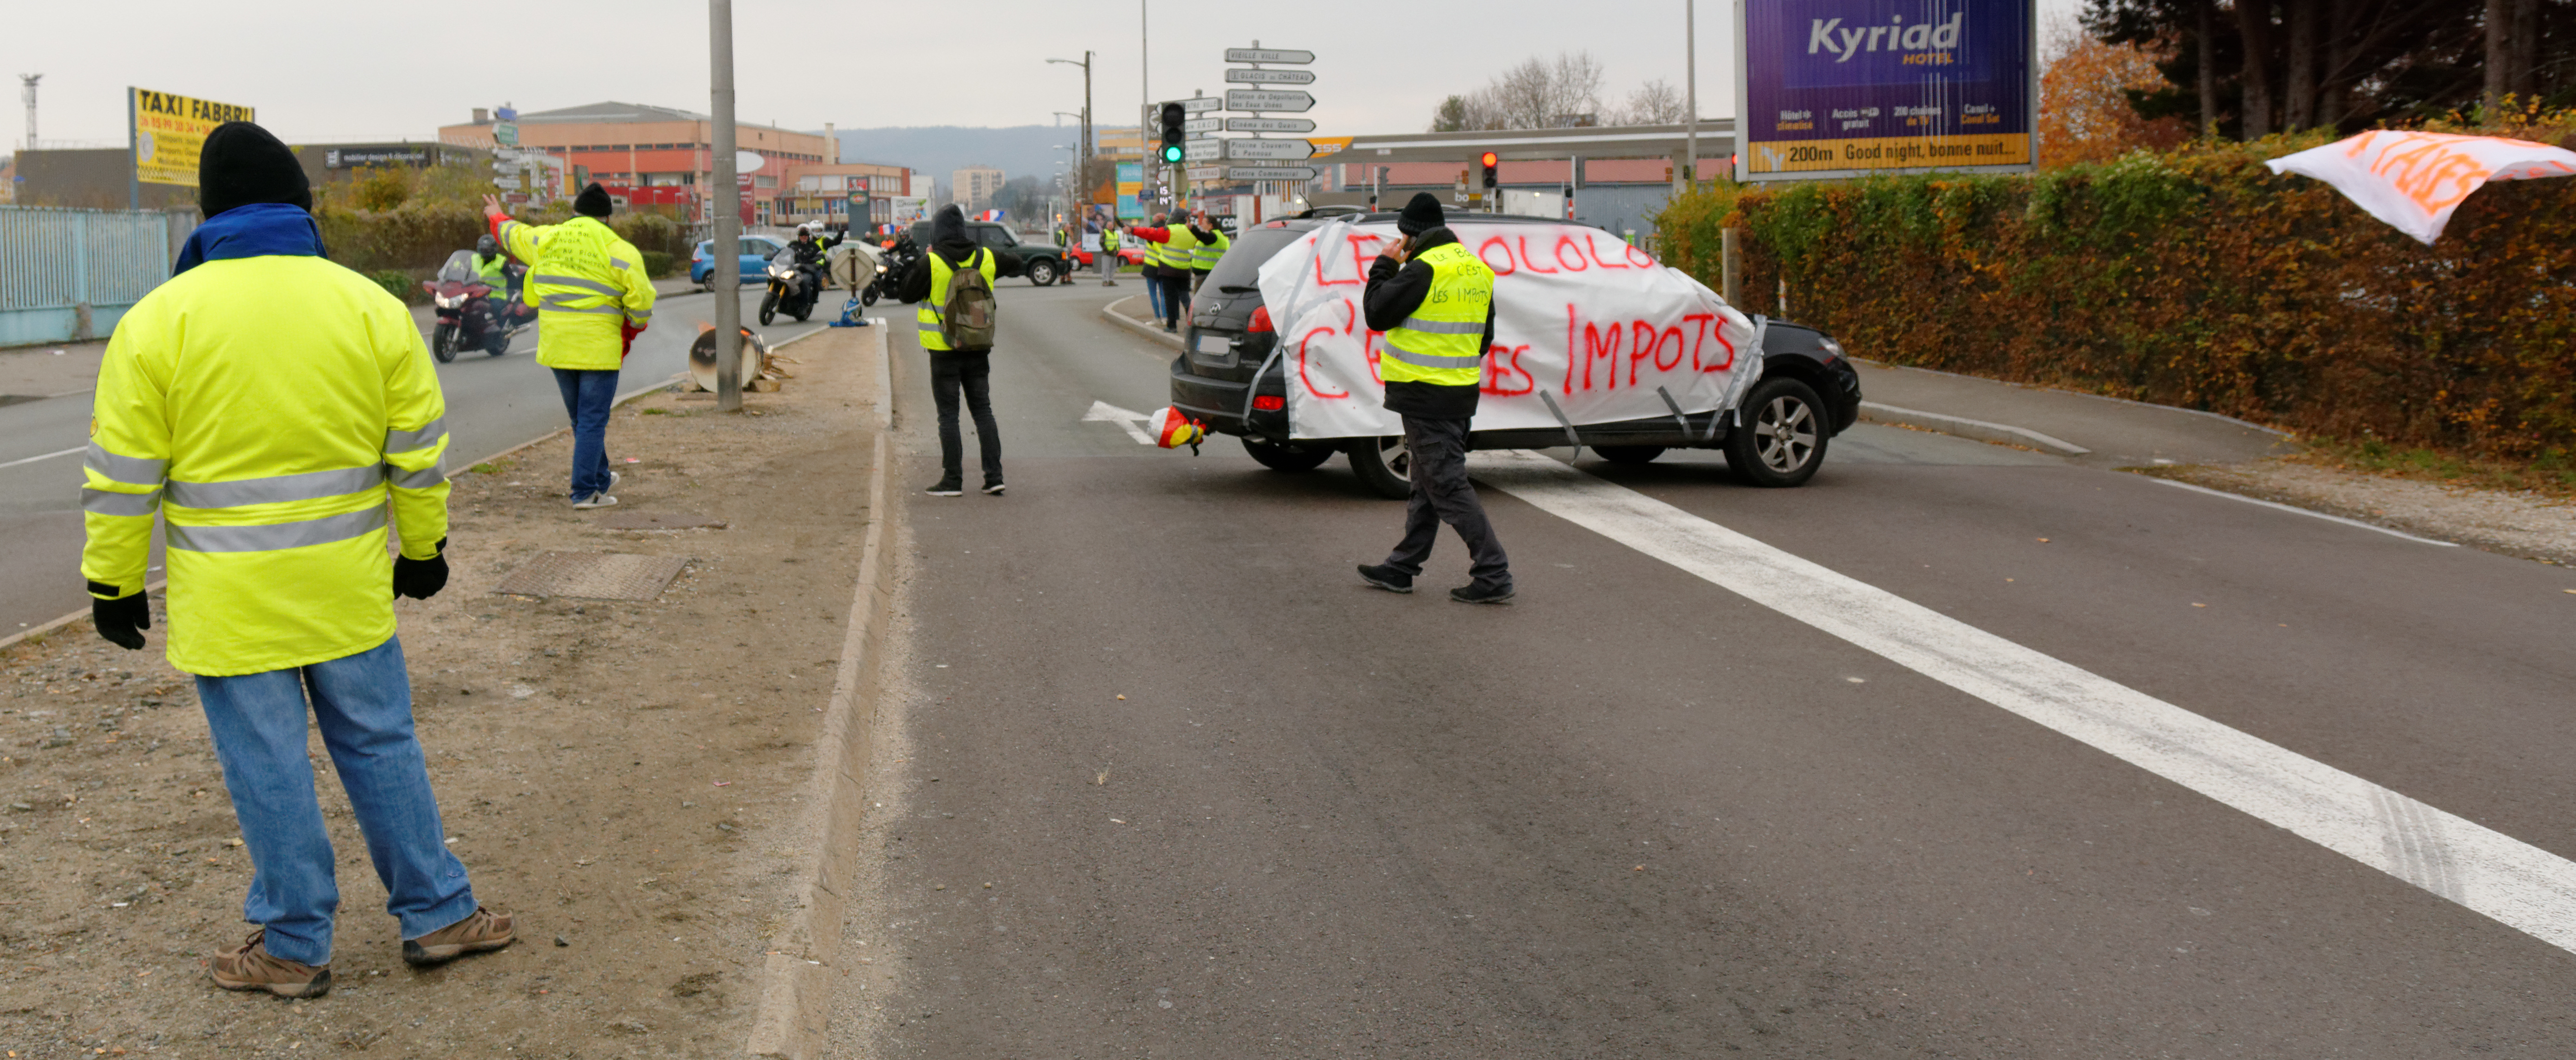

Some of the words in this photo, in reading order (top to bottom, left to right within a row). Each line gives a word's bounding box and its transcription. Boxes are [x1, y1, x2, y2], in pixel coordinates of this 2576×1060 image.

[1808, 12, 1964, 63] Kyriad
[1903, 53, 1954, 65] HOTEL
[1278, 72, 1309, 81] CHÂTEAU
[140, 91, 183, 116] TAXI
[192, 99, 248, 122] FABBRI
[1203, 99, 1217, 107] VILLE
[1313, 144, 1342, 153] ESS
[1790, 146, 1833, 162] 200m
[1846, 143, 1882, 160] Good
[1886, 142, 1926, 162] night,
[1929, 141, 1972, 157] bonne
[368, 153, 387, 163] design
[1433, 253, 1448, 262] LE
[1454, 248, 1476, 258] BO
[1458, 234, 1654, 277] OLOLO
[1457, 263, 1482, 276] C'EST
[1433, 285, 1448, 303] LES
[1458, 287, 1489, 306] IMPOTS
[1563, 302, 1735, 395] IMPOTS
